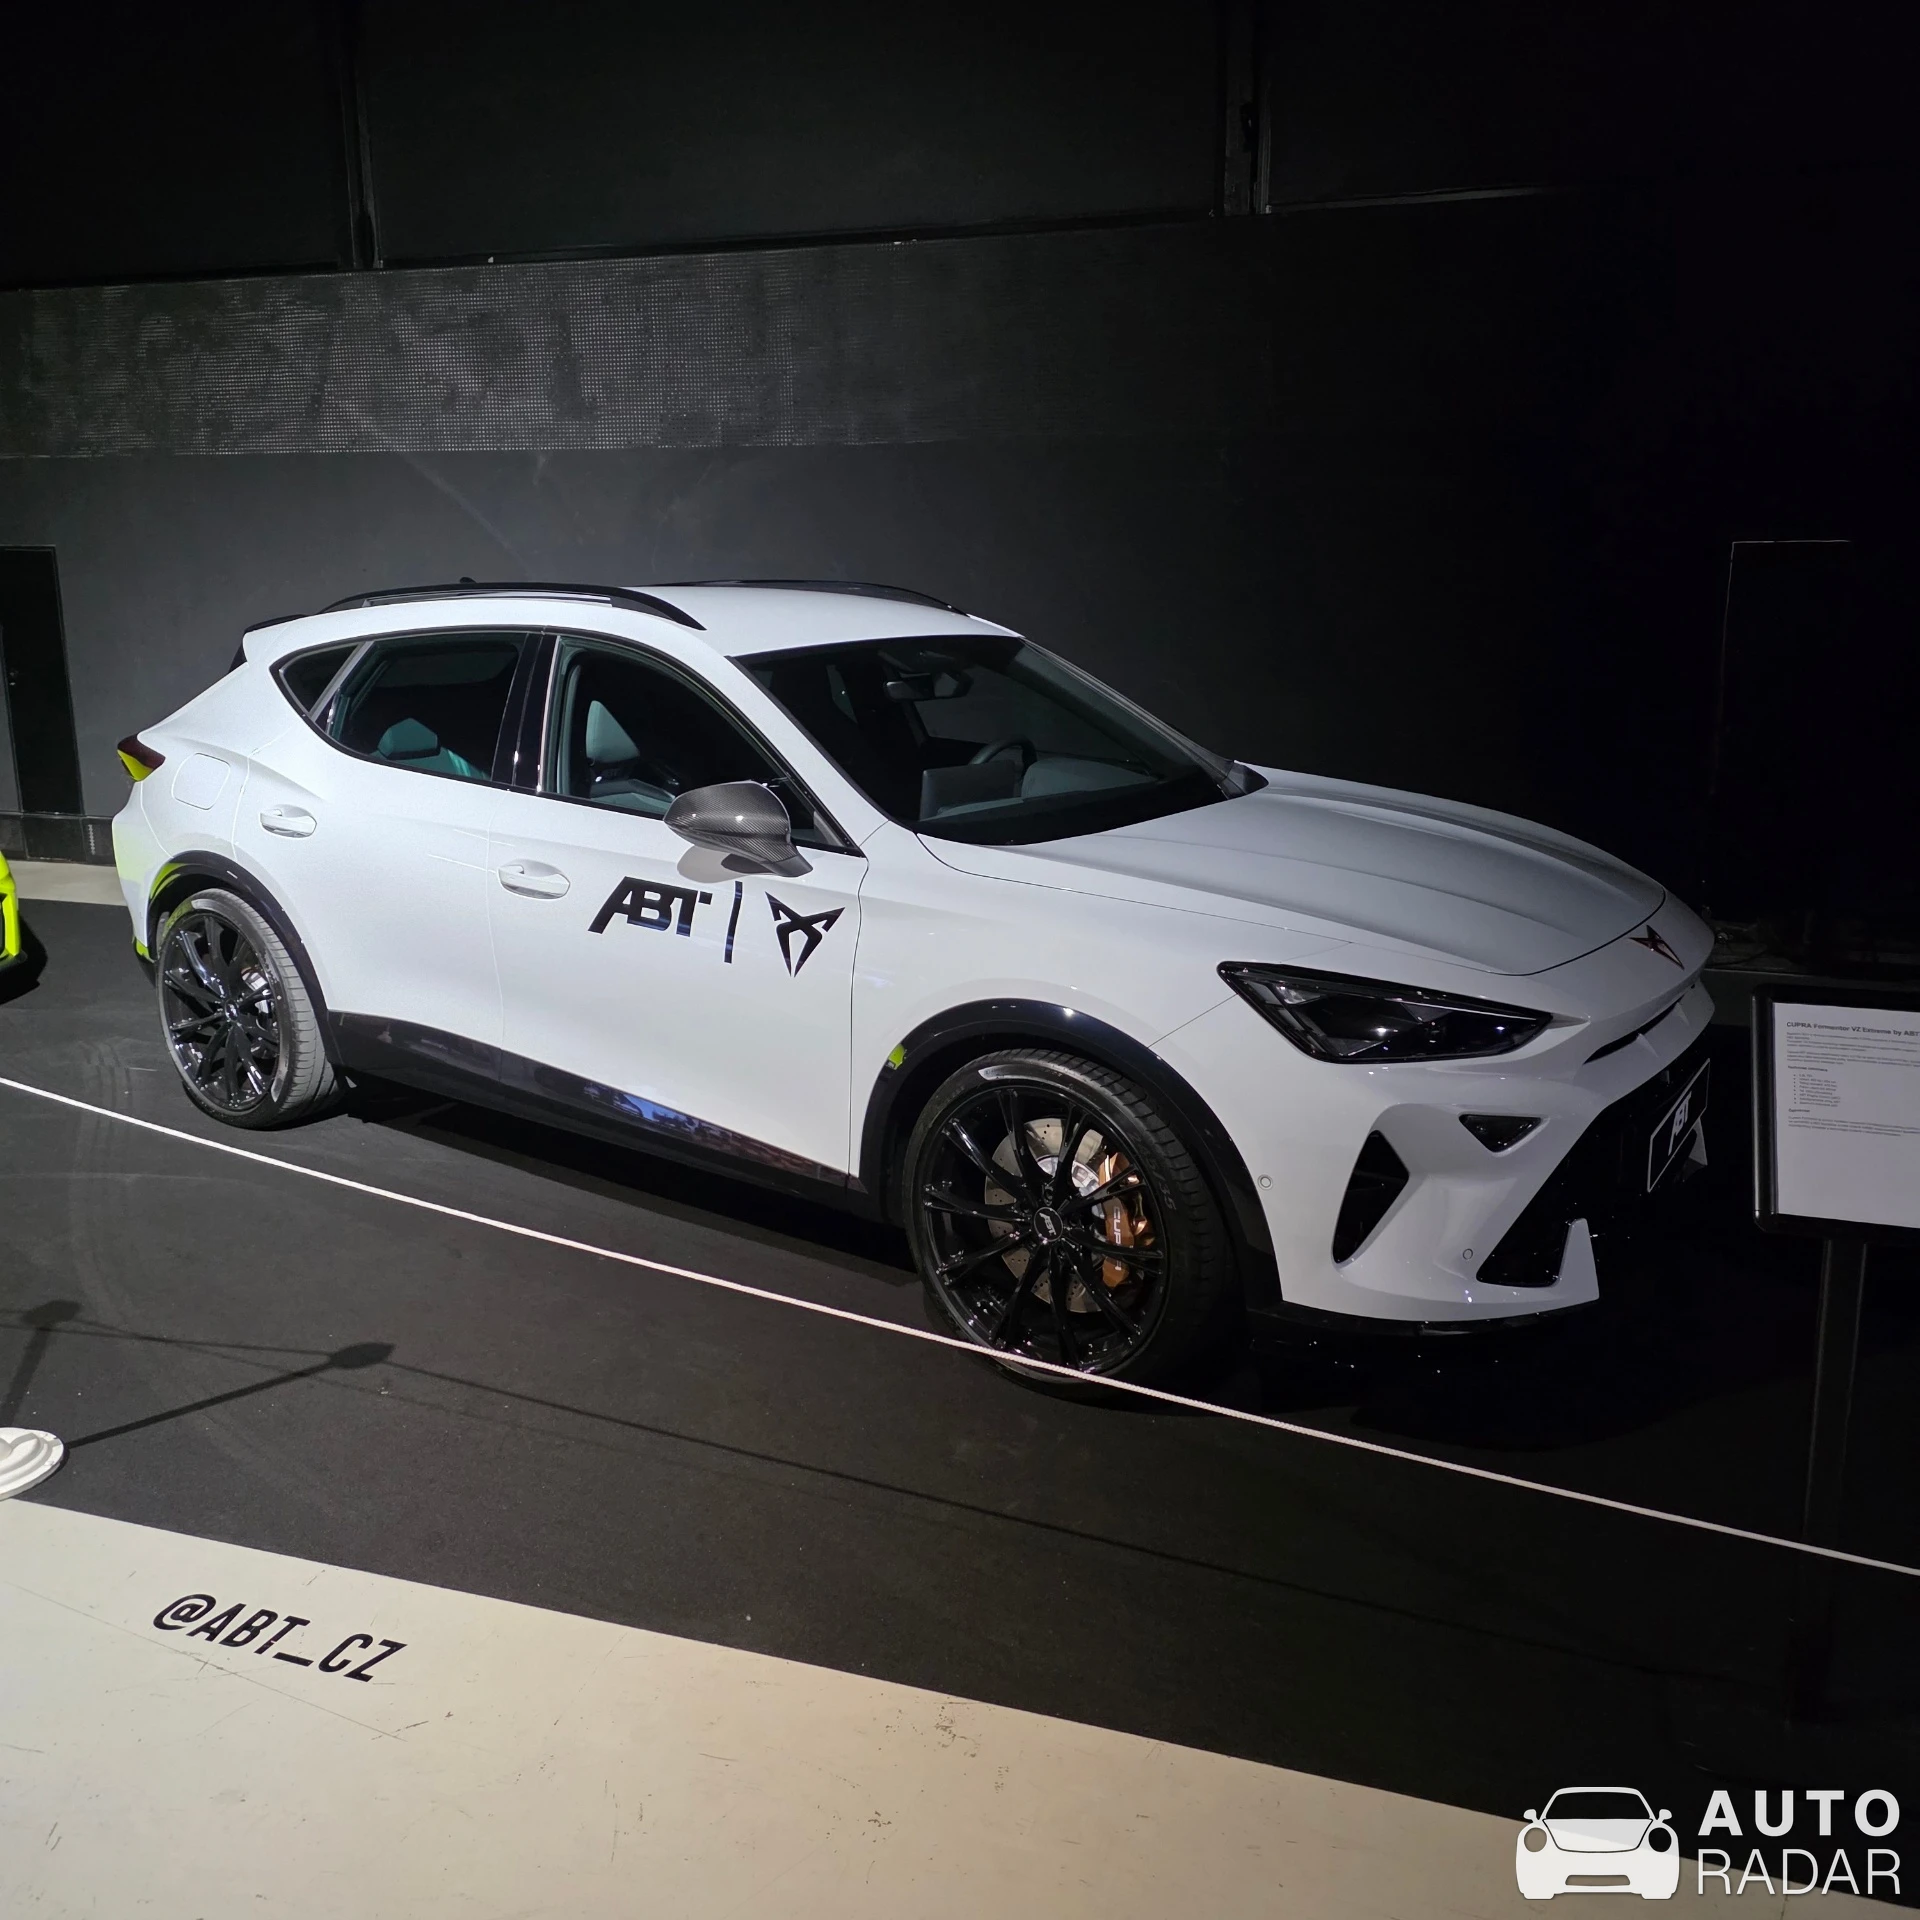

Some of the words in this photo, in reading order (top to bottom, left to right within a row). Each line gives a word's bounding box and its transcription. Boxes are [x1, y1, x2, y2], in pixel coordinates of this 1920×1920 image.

[588, 876, 713, 937] ABT
[1786, 1021, 1812, 1029] CUPRA
[1893, 1029, 1902, 1037] by
[1668, 1091, 1692, 1156] ABT
[153, 1593, 408, 1682] @ABT_CZ
